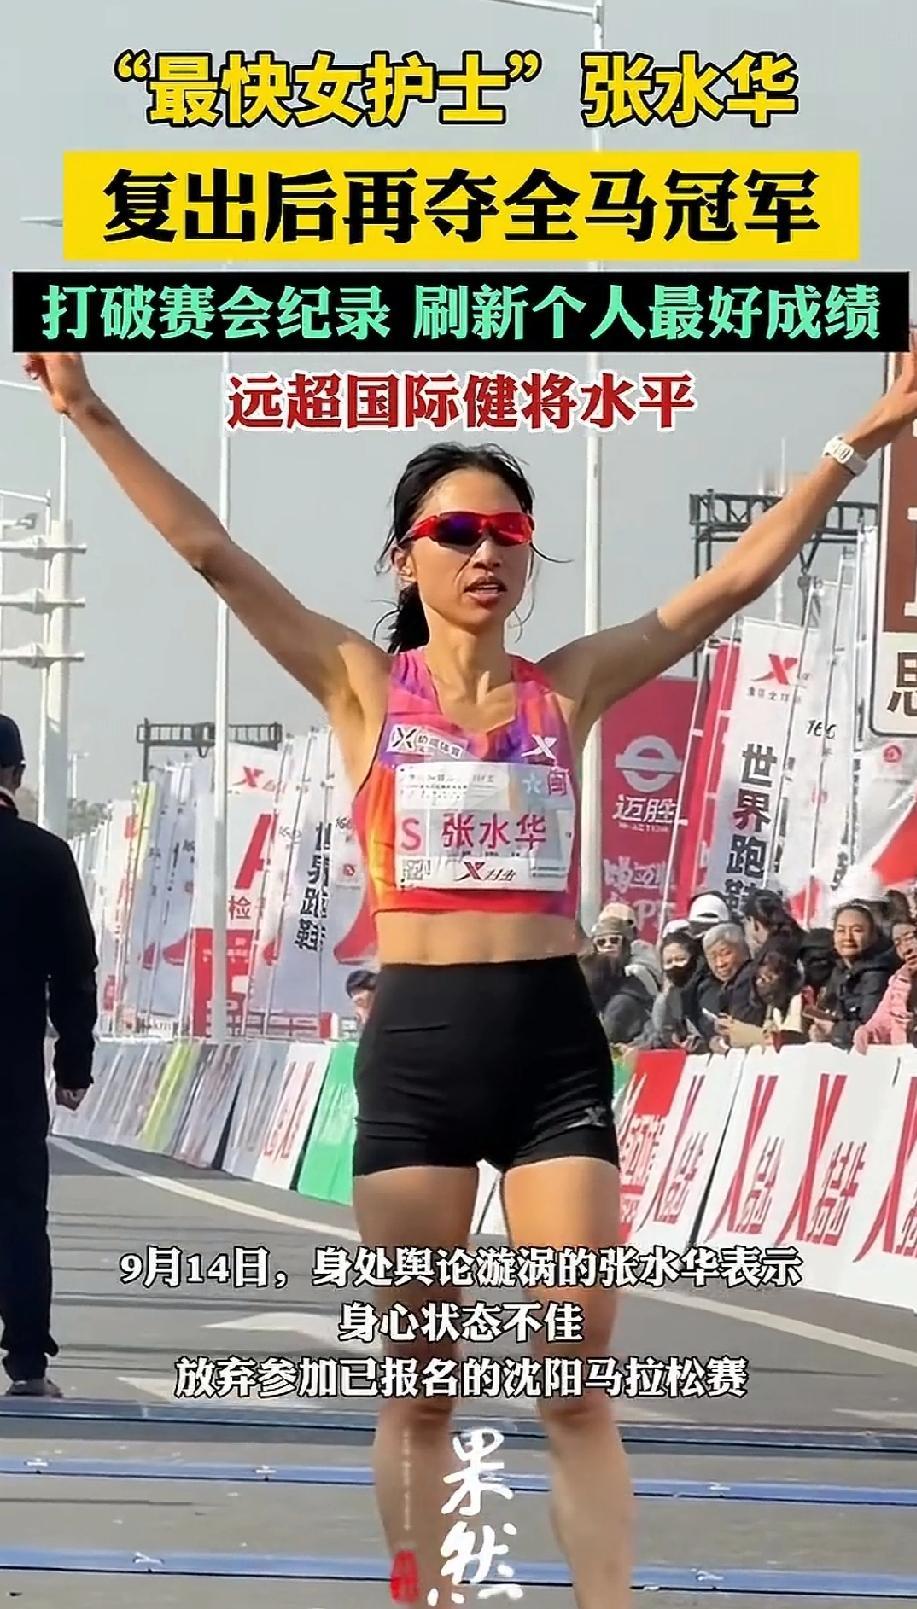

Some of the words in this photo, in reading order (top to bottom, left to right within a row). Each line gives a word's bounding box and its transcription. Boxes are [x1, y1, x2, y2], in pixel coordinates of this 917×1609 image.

[400, 817, 422, 851] S
[441, 812, 547, 850] 张水华
